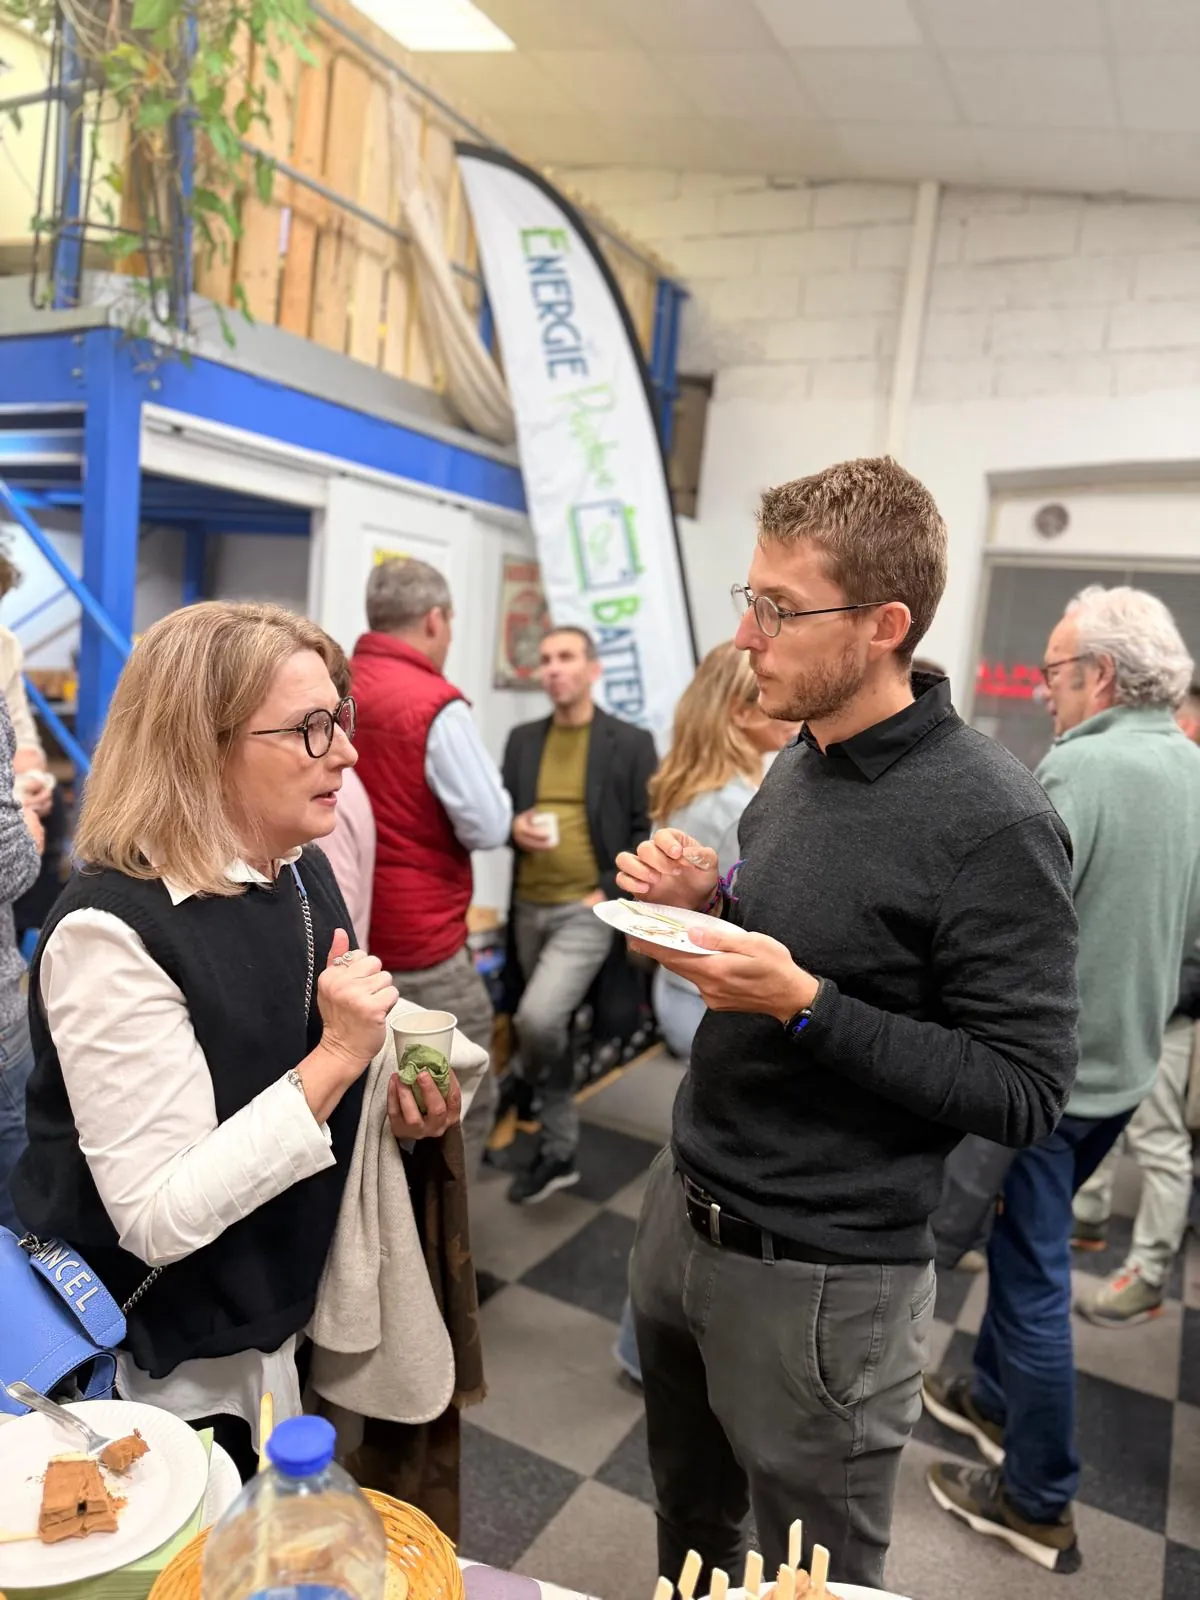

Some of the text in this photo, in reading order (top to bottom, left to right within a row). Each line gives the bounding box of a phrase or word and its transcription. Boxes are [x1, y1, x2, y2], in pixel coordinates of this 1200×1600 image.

[520, 226, 588, 379] ENERGIE
[591, 596, 649, 724] BATTER
[34, 1240, 98, 1312] ANCEL
